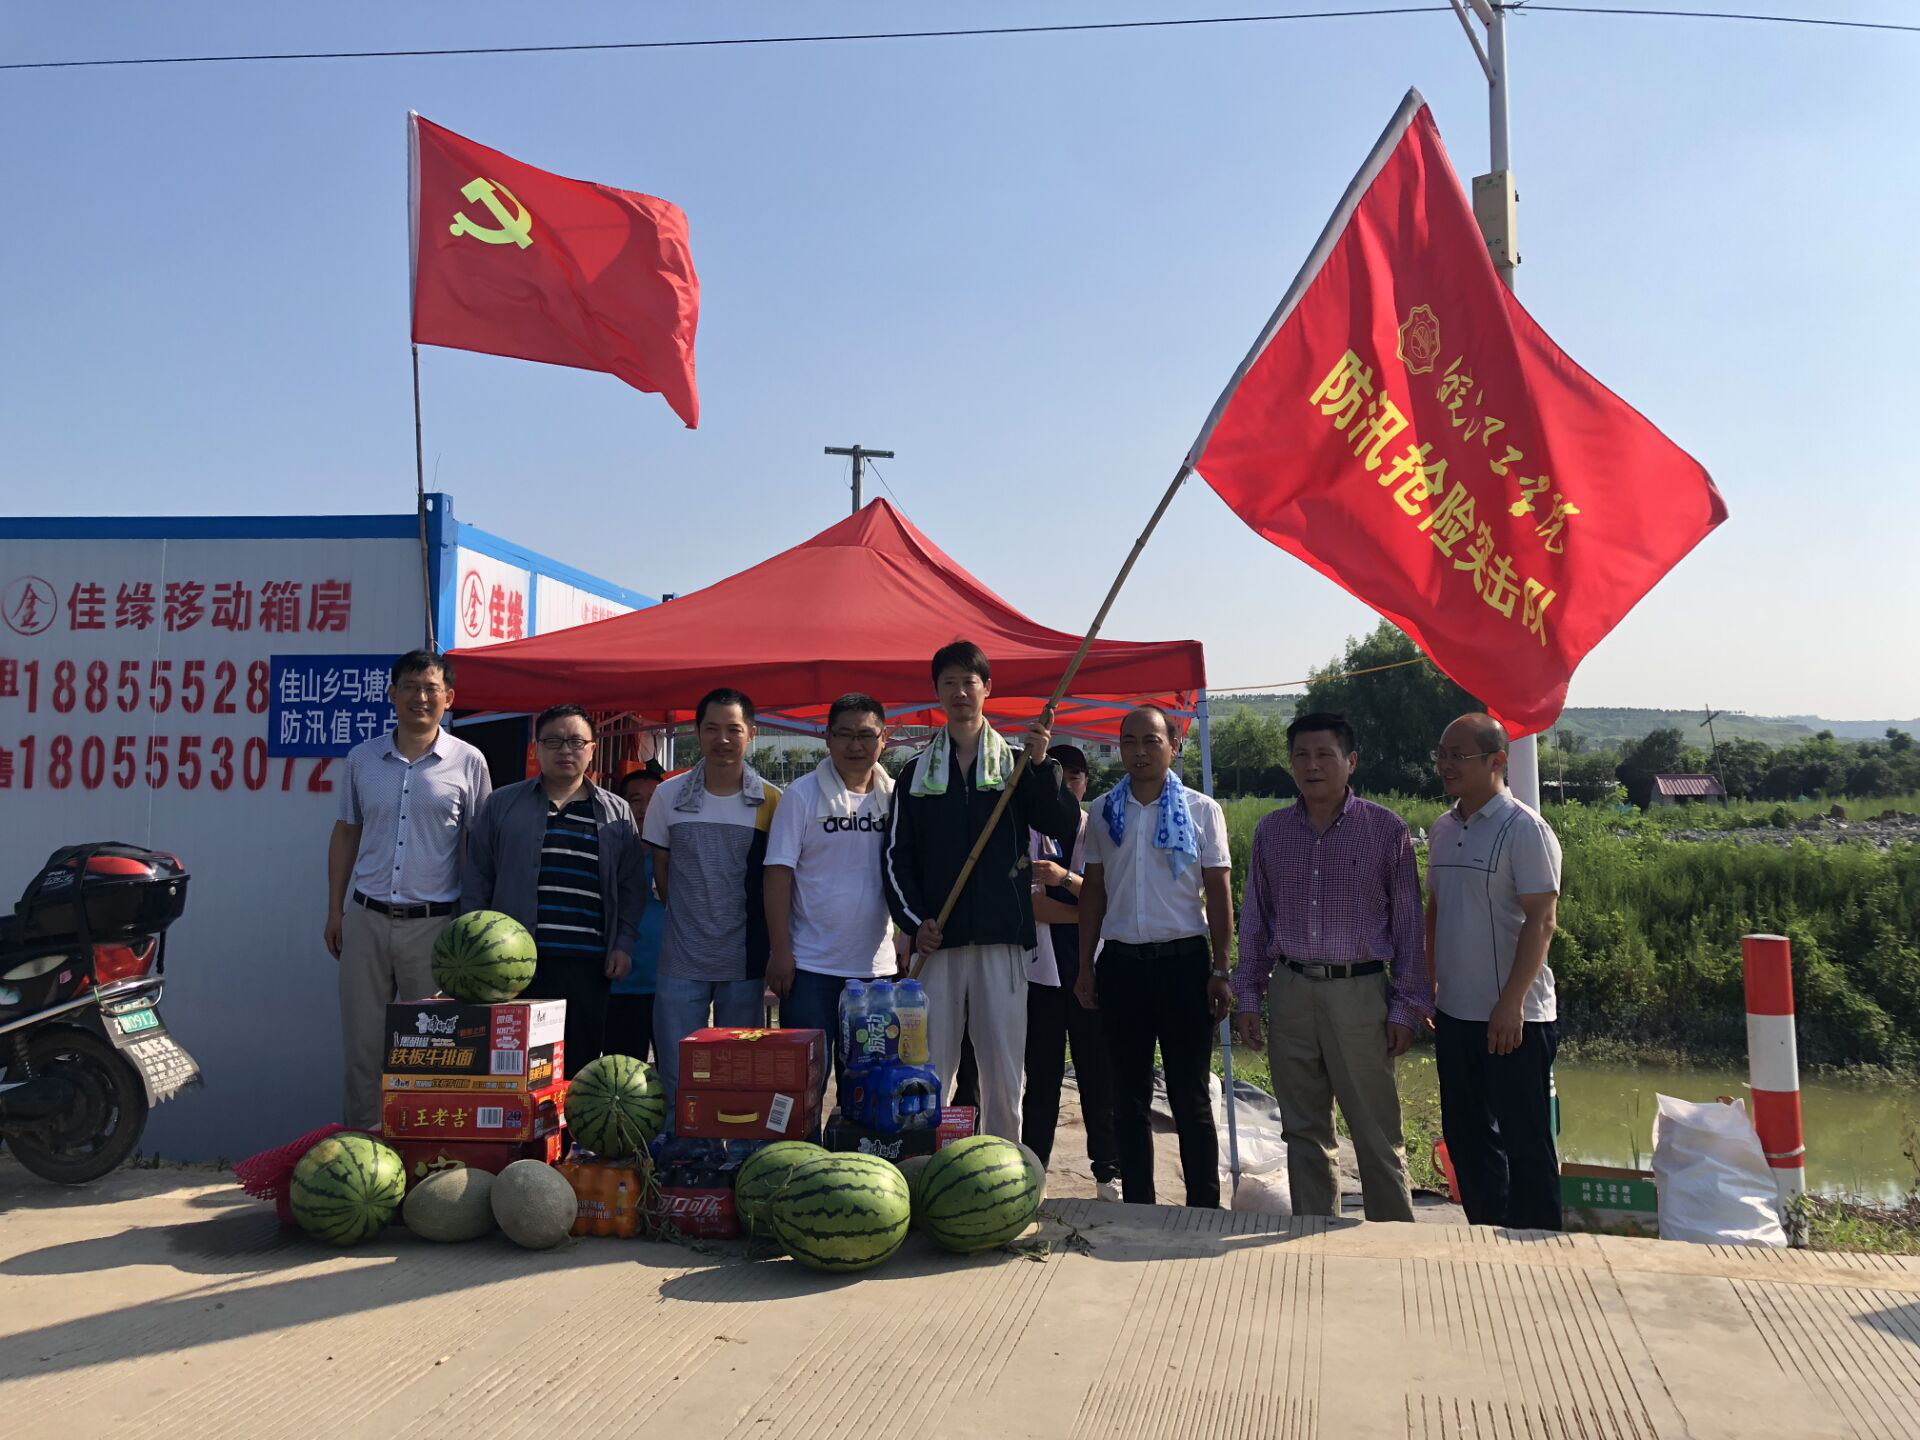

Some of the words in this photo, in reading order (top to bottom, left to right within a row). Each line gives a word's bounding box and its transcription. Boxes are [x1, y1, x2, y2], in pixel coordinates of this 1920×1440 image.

[1309, 348, 1557, 647] 防汛抢险突击队
[67, 579, 352, 633] 佳缘移动箱房
[489, 584, 524, 640] 佳缘
[390, 1048, 474, 1067] 铁板牛排面
[413, 1108, 468, 1128] 王老吉
[657, 1194, 727, 1216] 可口可乐
